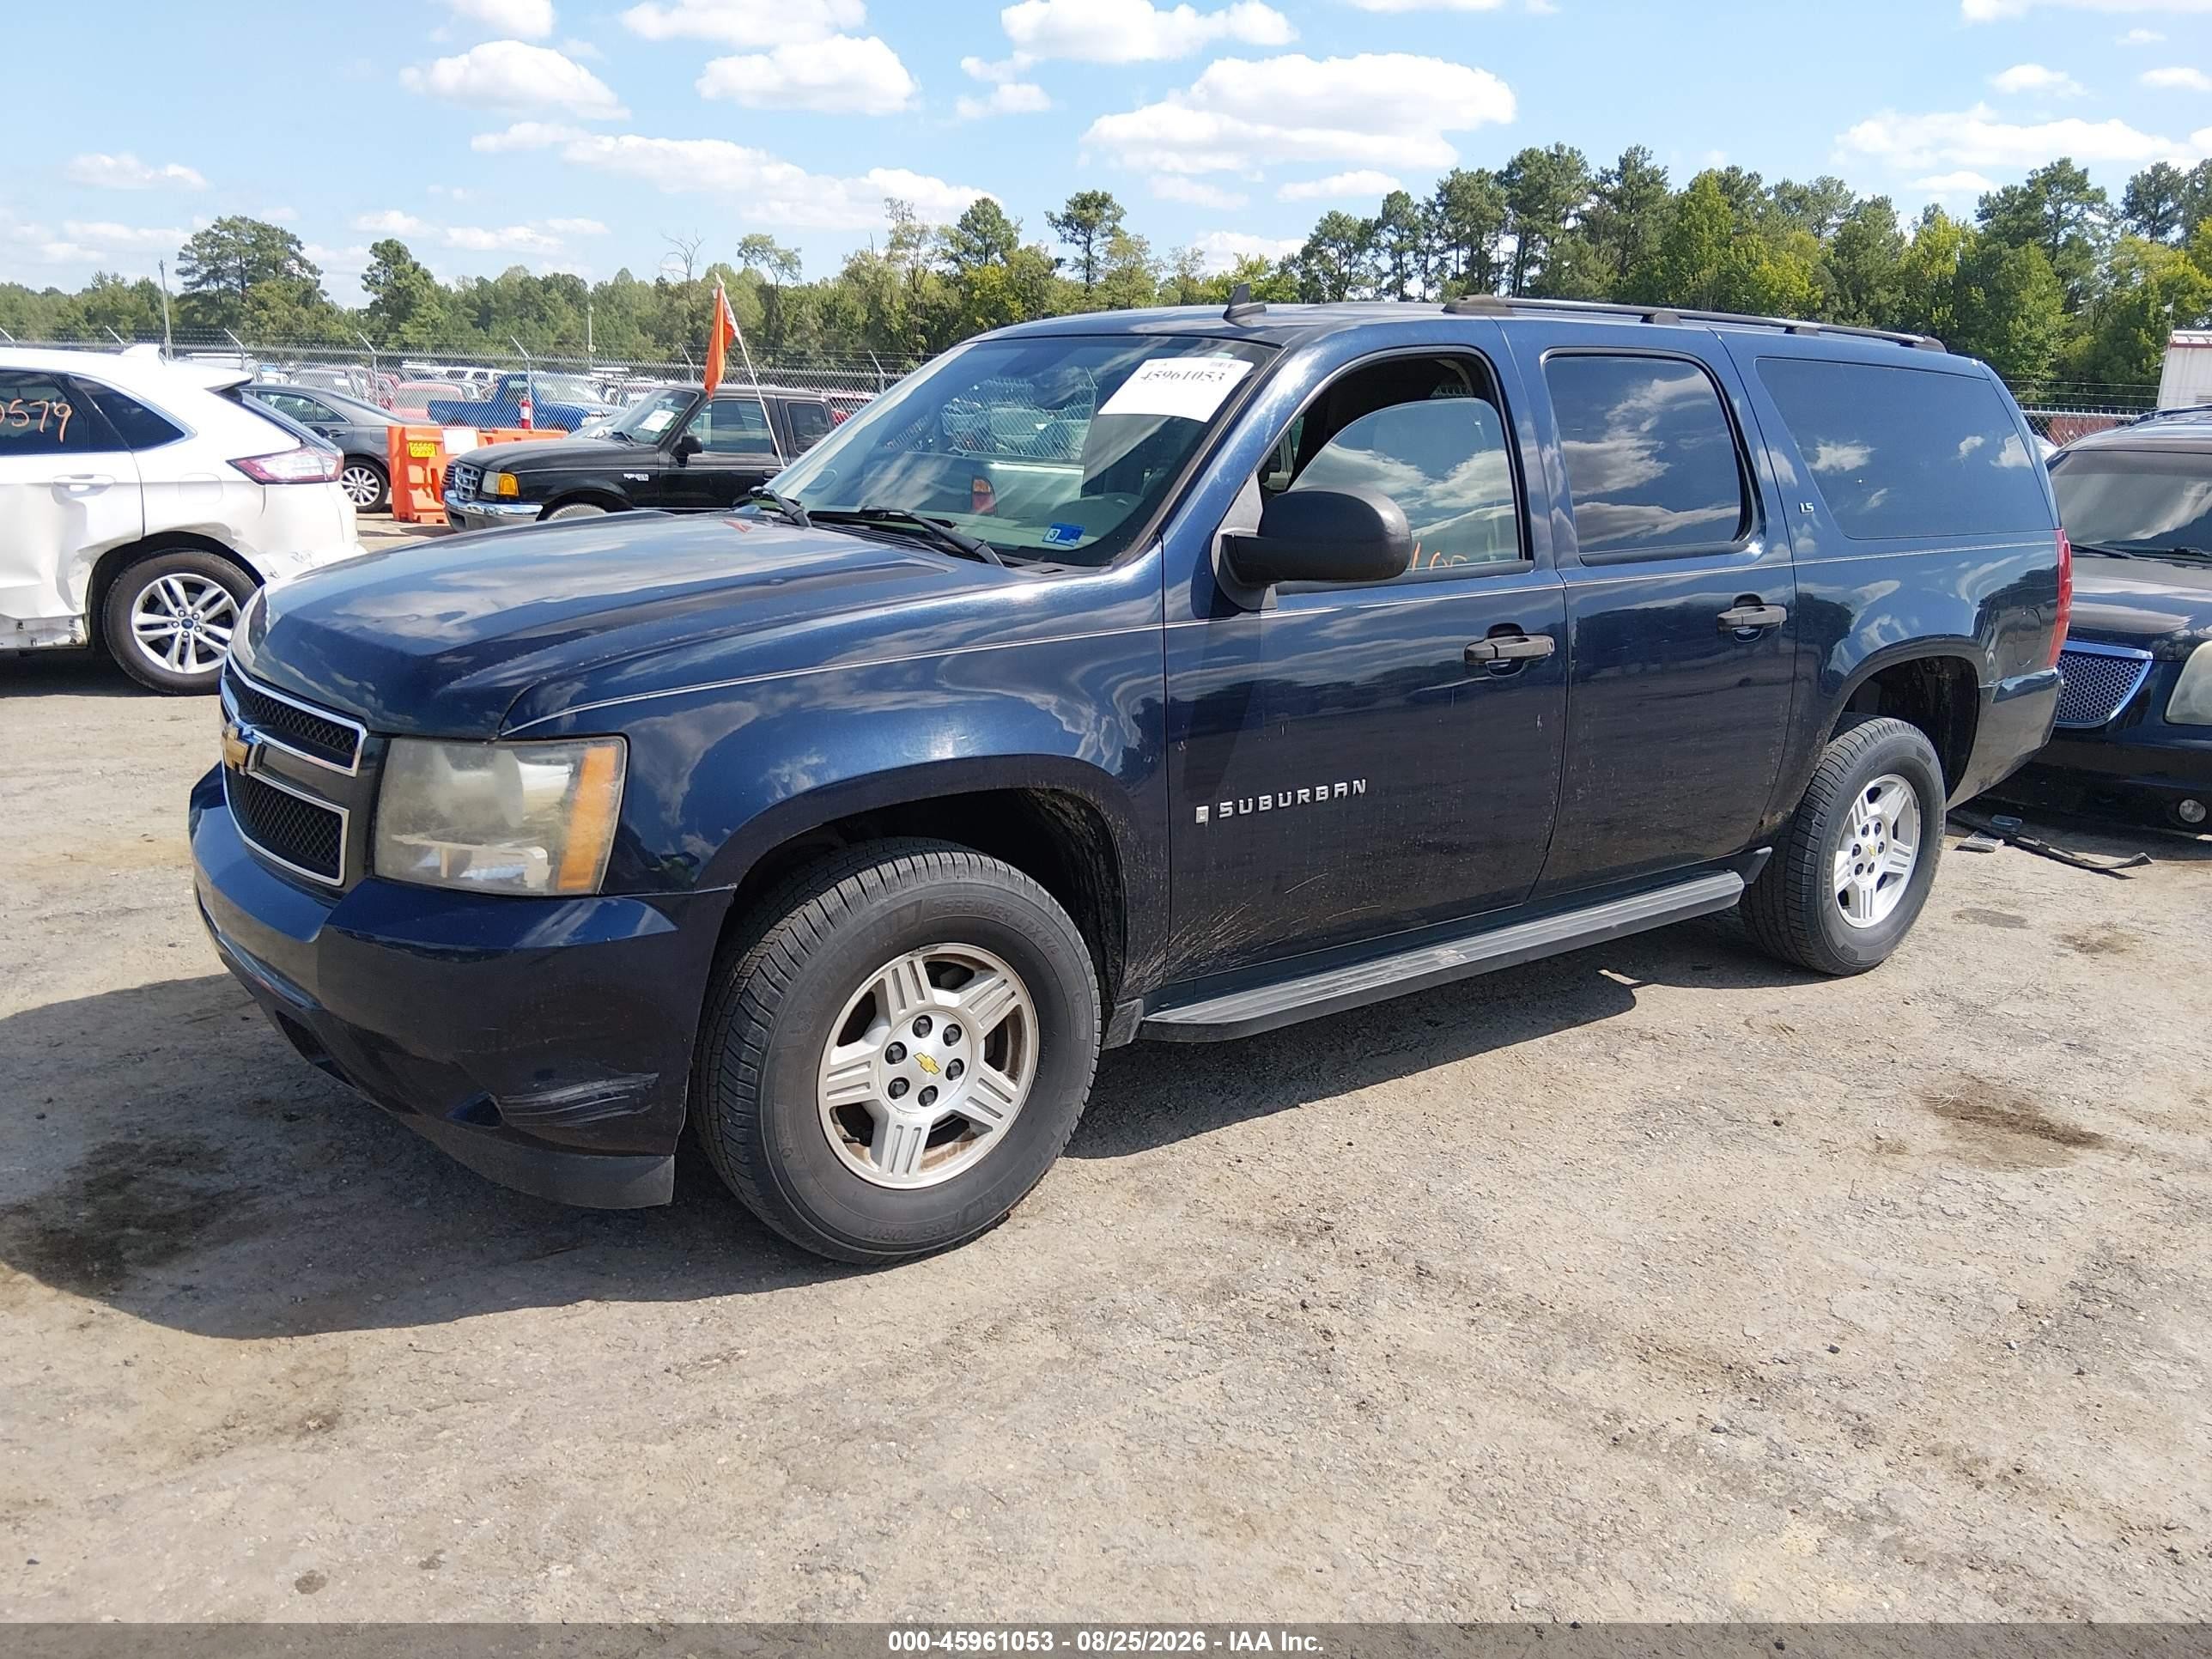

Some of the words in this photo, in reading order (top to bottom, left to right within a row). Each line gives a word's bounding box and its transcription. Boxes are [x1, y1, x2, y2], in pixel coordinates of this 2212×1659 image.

[1799, 501, 1814, 514] LS
[1218, 778, 1367, 818] SUBURBAN
[933, 901, 1011, 922] DEFENDER
